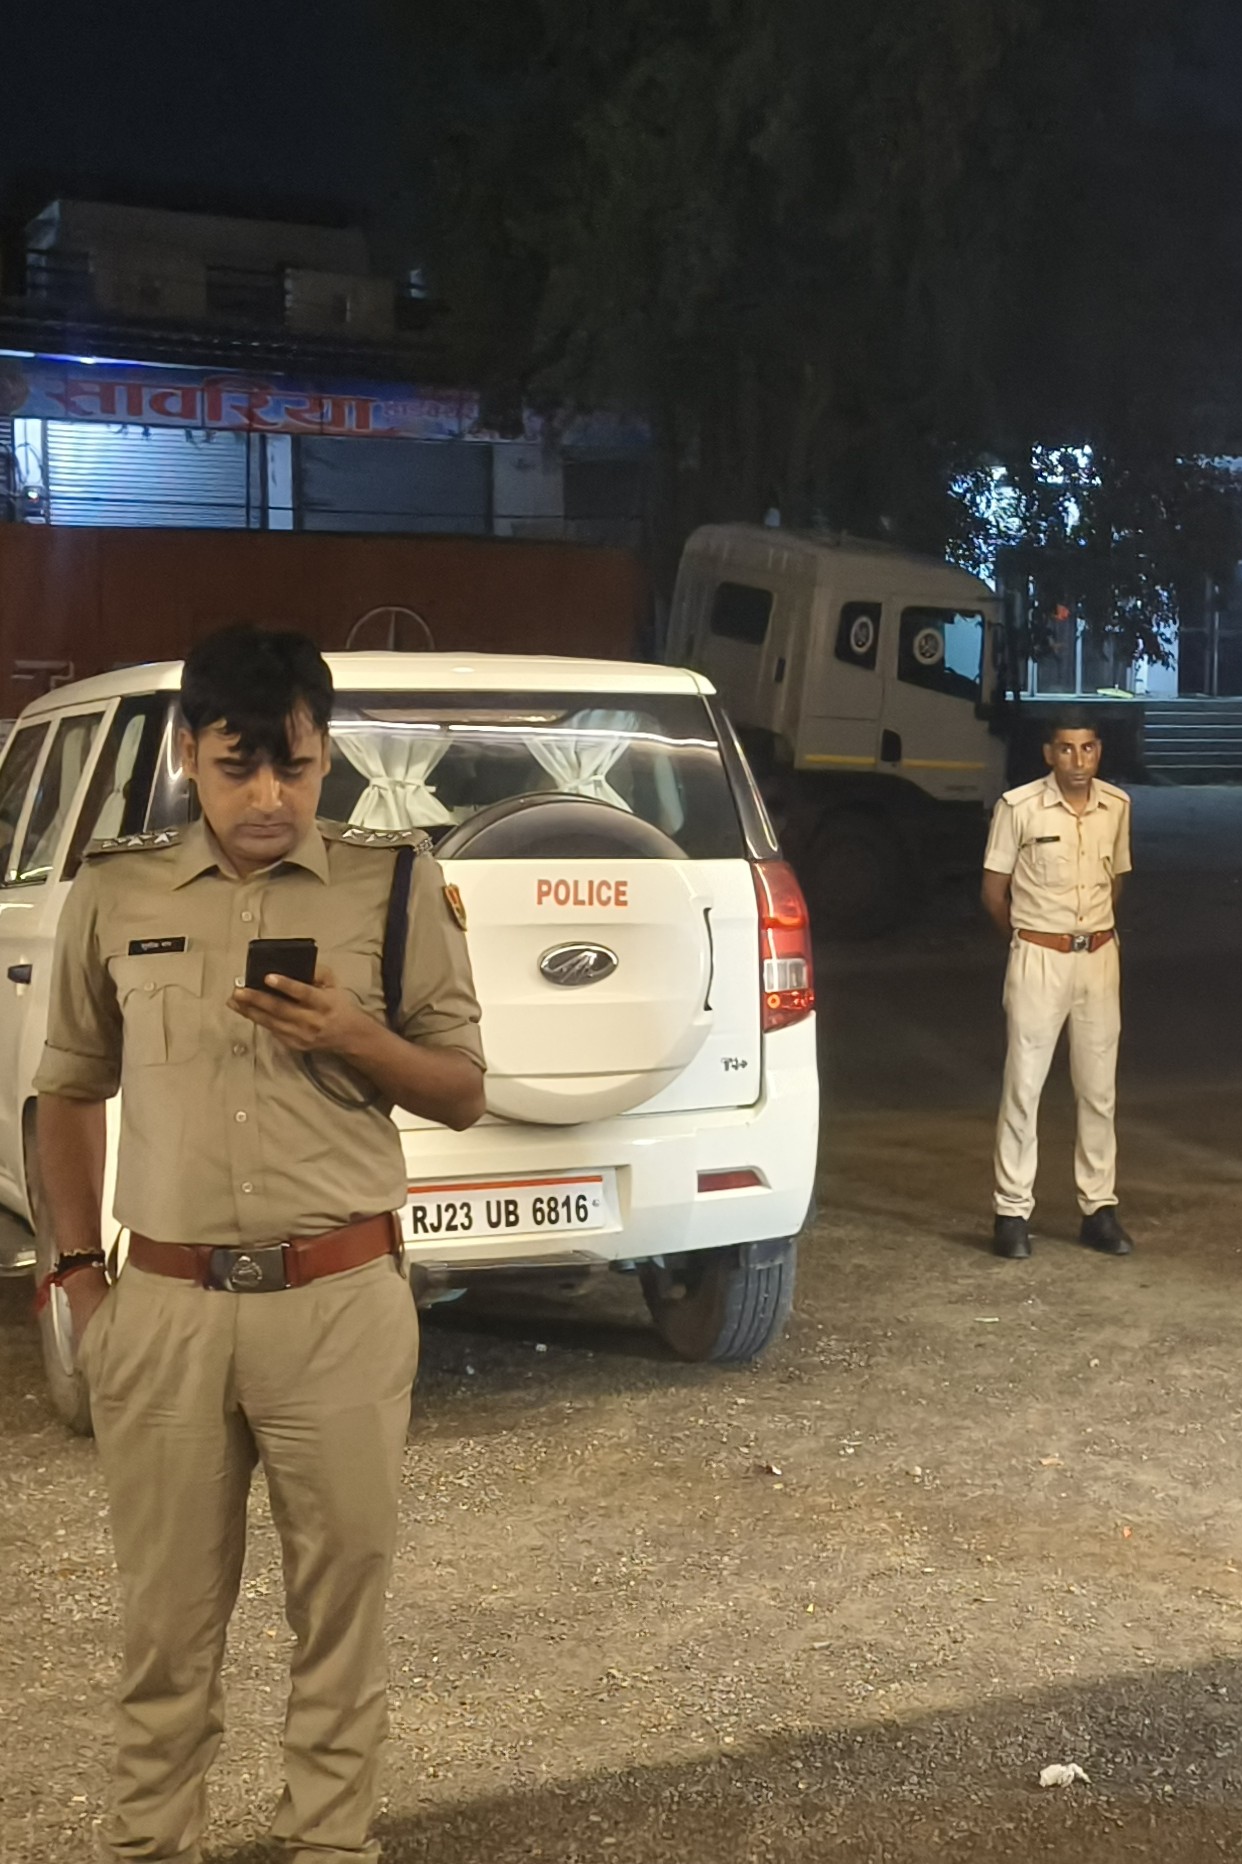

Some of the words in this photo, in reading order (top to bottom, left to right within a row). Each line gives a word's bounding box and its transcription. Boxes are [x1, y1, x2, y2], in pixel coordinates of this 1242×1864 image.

[537, 879, 628, 906] POLICE
[412, 1202, 473, 1234] RJ23
[486, 1199, 520, 1228] UB
[532, 1194, 589, 1226] 6816
